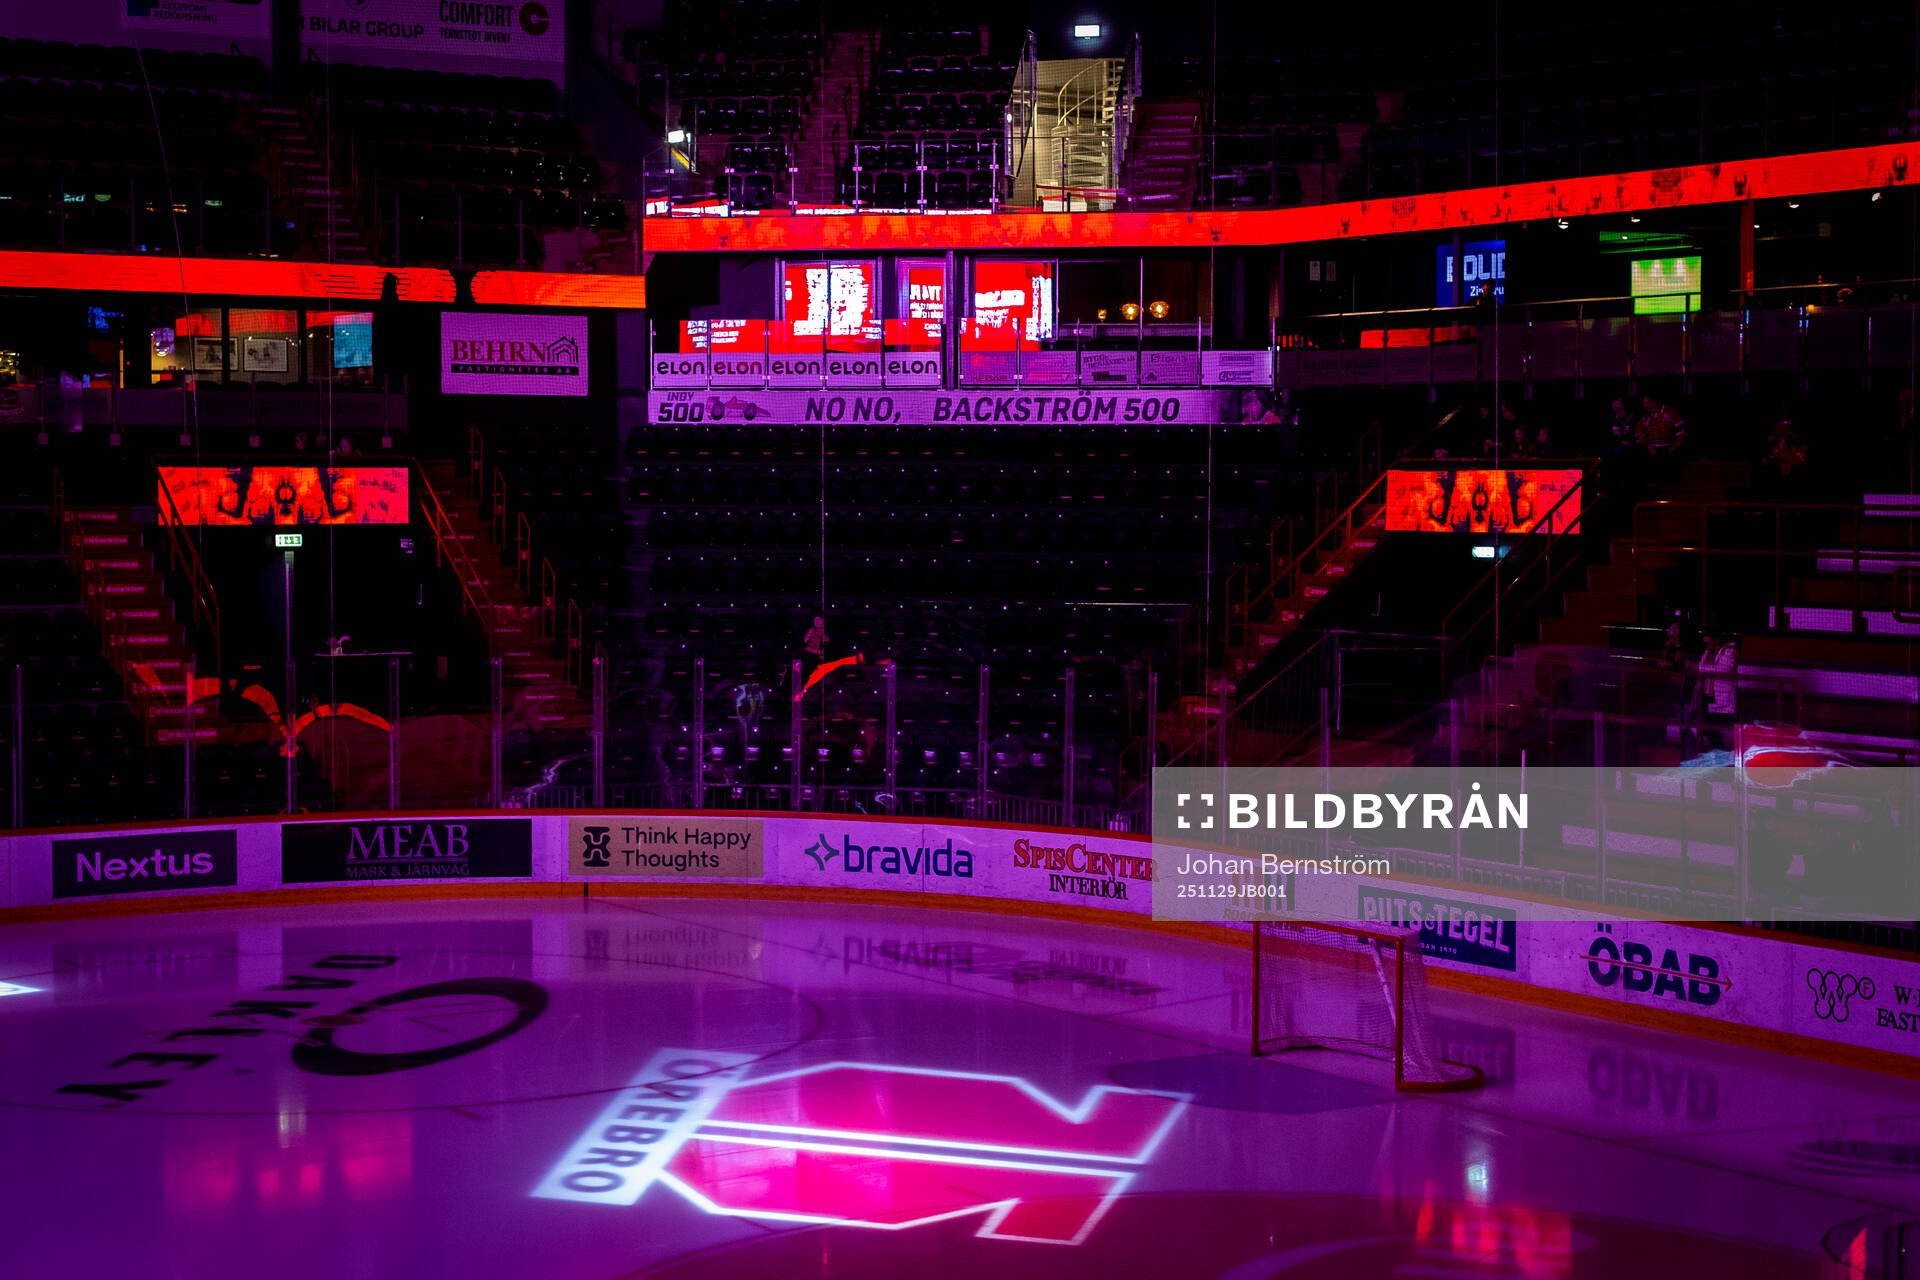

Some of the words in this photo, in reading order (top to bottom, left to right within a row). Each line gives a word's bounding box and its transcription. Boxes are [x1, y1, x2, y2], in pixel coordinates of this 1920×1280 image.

[309, 16, 361, 34] BILAR
[365, 20, 425, 38] GROUP
[439, 1, 513, 27] COMFORT
[452, 339, 546, 363] BEHRN
[667, 391, 695, 401] INDY
[805, 397, 847, 422] NO
[852, 396, 901, 423] NO,
[932, 390, 1118, 422] BACKSTRÖM
[1123, 398, 1181, 422] 500
[658, 402, 705, 422] 500
[345, 823, 470, 859] MEAB
[621, 826, 679, 845] Think
[684, 828, 752, 850] Happy
[75, 849, 215, 883] Nextus
[621, 849, 720, 872] Thoughts
[843, 834, 974, 879] bravida
[345, 865, 387, 879] MARK
[391, 865, 400, 877] &
[1048, 873, 1128, 900] INTERIÖR
[1587, 922, 1721, 1006] ÖBAB
[559, 1058, 732, 1193] ÖREBRO
